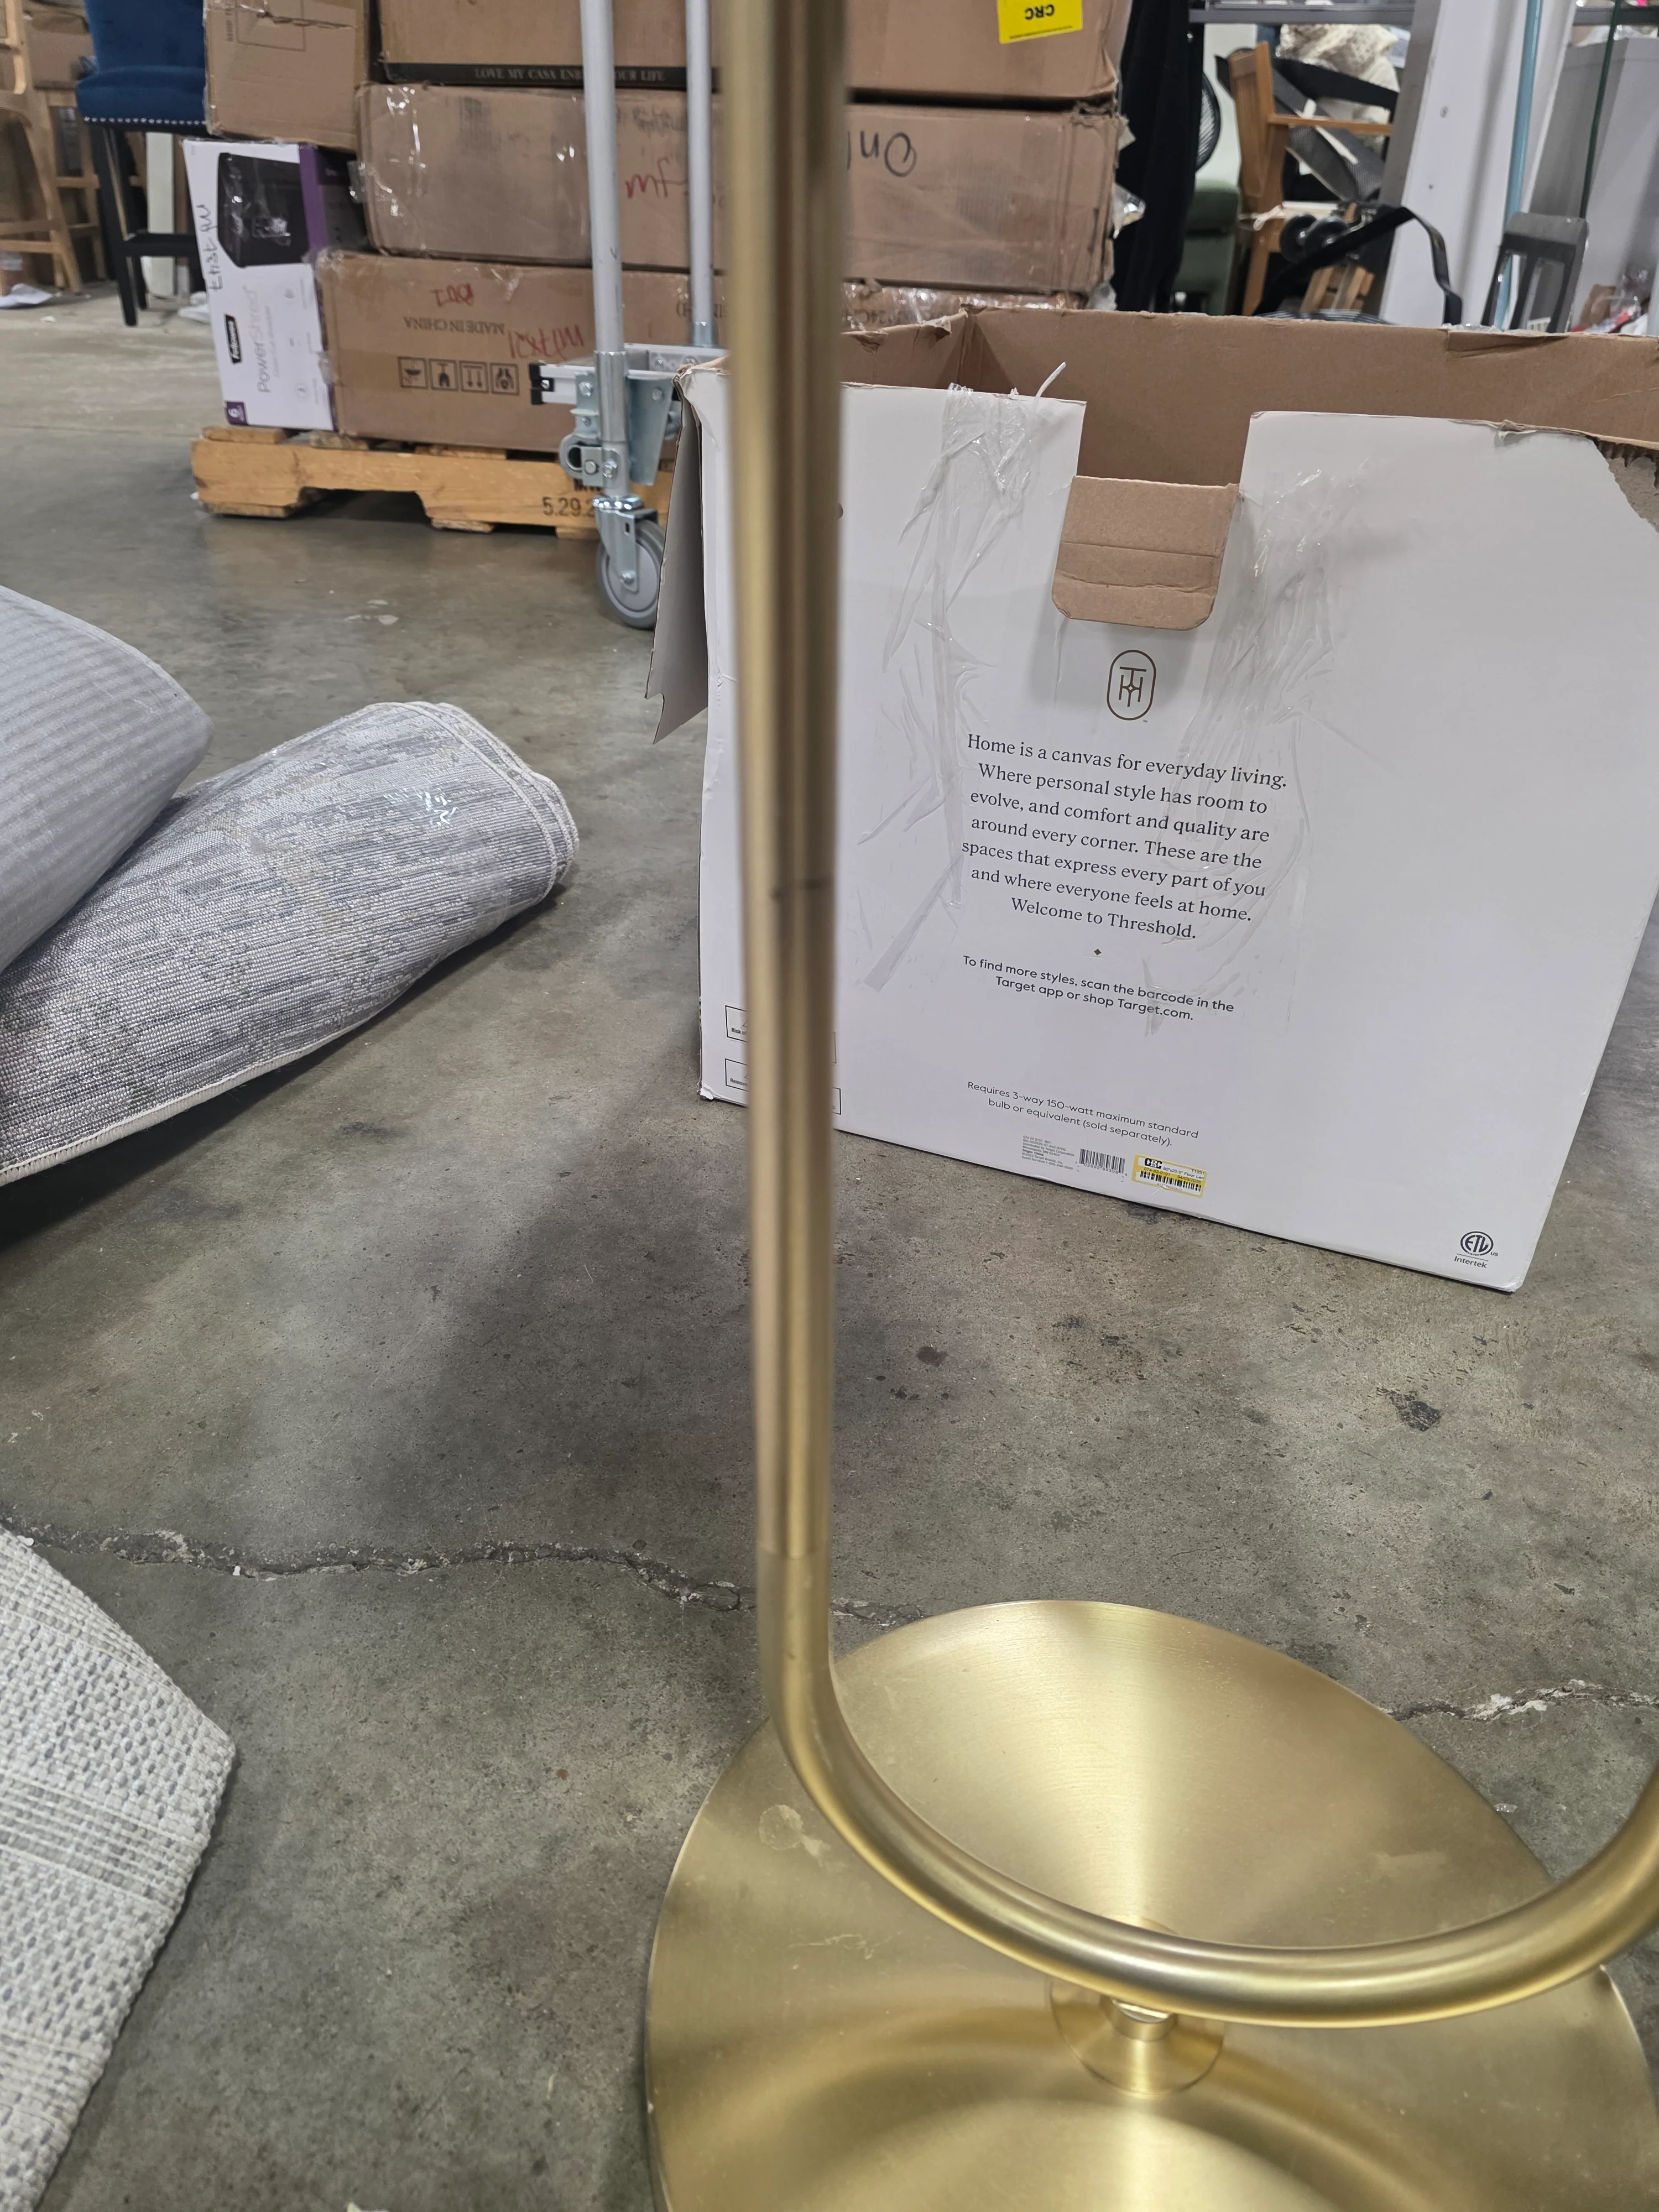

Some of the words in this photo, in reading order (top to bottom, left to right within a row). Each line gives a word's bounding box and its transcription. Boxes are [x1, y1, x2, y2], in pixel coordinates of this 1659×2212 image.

[1025, 4, 1055, 20] CRC
[474, 68, 504, 79] LOVE
[507, 68, 525, 79] MY
[528, 69, 556, 80] CASA
[640, 70, 665, 81] LIFE
[403, 316, 448, 332] CHINA
[450, 320, 465, 333] IN
[466, 320, 505, 336] MADE
[228, 406, 239, 418] 6
[968, 734, 1015, 754] Home
[1020, 742, 1032, 757] is
[1038, 749, 1047, 759] a
[1052, 751, 1112, 767] canvas
[1117, 754, 1141, 770] for
[1146, 762, 1227, 783] everyday
[1231, 766, 1286, 790] living.
[979, 763, 1031, 784] Where
[1036, 776, 1109, 795] personal
[1114, 785, 1155, 801] style
[1160, 787, 1191, 804] has
[1197, 796, 1243, 811] room
[1250, 800, 1267, 813] to
[971, 793, 1023, 812] evolve,
[1029, 802, 1059, 815] and
[1065, 807, 1131, 825] comfort
[1136, 815, 1168, 830] and
[1173, 821, 1237, 841] quality
[1240, 830, 1269, 842] are
[972, 820, 1027, 837] around
[1032, 830, 1077, 846] every
[1081, 836, 1138, 853] corner.
[1144, 841, 1196, 859] These
[1201, 852, 1228, 864] are
[1233, 853, 1261, 868] the
[962, 843, 1013, 860] spaces
[1018, 849, 1050, 866] that
[1055, 859, 1116, 875] express
[1121, 868, 1168, 885] every
[1171, 875, 1208, 888] part
[1213, 878, 1232, 891] of
[1233, 883, 1265, 896] you
[972, 870, 999, 883] and
[1004, 874, 1051, 891] where
[1056, 884, 1130, 903] everyone
[1135, 892, 1172, 909] feels
[1178, 901, 1194, 912] at
[1199, 900, 1251, 921] home.
[1011, 898, 1082, 920] Welcome
[1087, 912, 1102, 924] to
[1108, 913, 1196, 938] Threshold.
[963, 956, 976, 966] To
[980, 959, 1002, 971] find
[1006, 967, 1037, 978] more
[1041, 972, 1077, 987] styles,
[1081, 980, 1109, 991] scan
[1113, 984, 1134, 995] the
[1138, 987, 1193, 1005] barcode
[1197, 997, 1208, 1008] in
[1212, 1000, 1234, 1011] the
[996, 976, 1035, 992] Target
[1039, 987, 1063, 999] app
[1083, 993, 1114, 1008] shop
[1118, 999, 1193, 1020] Target.com.
[968, 1082, 1010, 1097] Requires
[1013, 1092, 1044, 1106] 3-way
[1047, 1099, 1093, 1115] 150-watt
[1097, 1112, 1145, 1126] maximum
[1148, 1123, 1198, 1138] standard
[989, 1098, 1010, 1109] bulb
[1027, 1109, 1081, 1125] equivalent
[1083, 1120, 1107, 1131] (sold
[1110, 1127, 1172, 1147] separately).
[1144, 1158, 1162, 1170] CRC
[1144, 1167, 1170, 1176] 074-02-0101
[1454, 1255, 1487, 1269] Intertek
[1464, 1234, 1489, 1253] ETL
